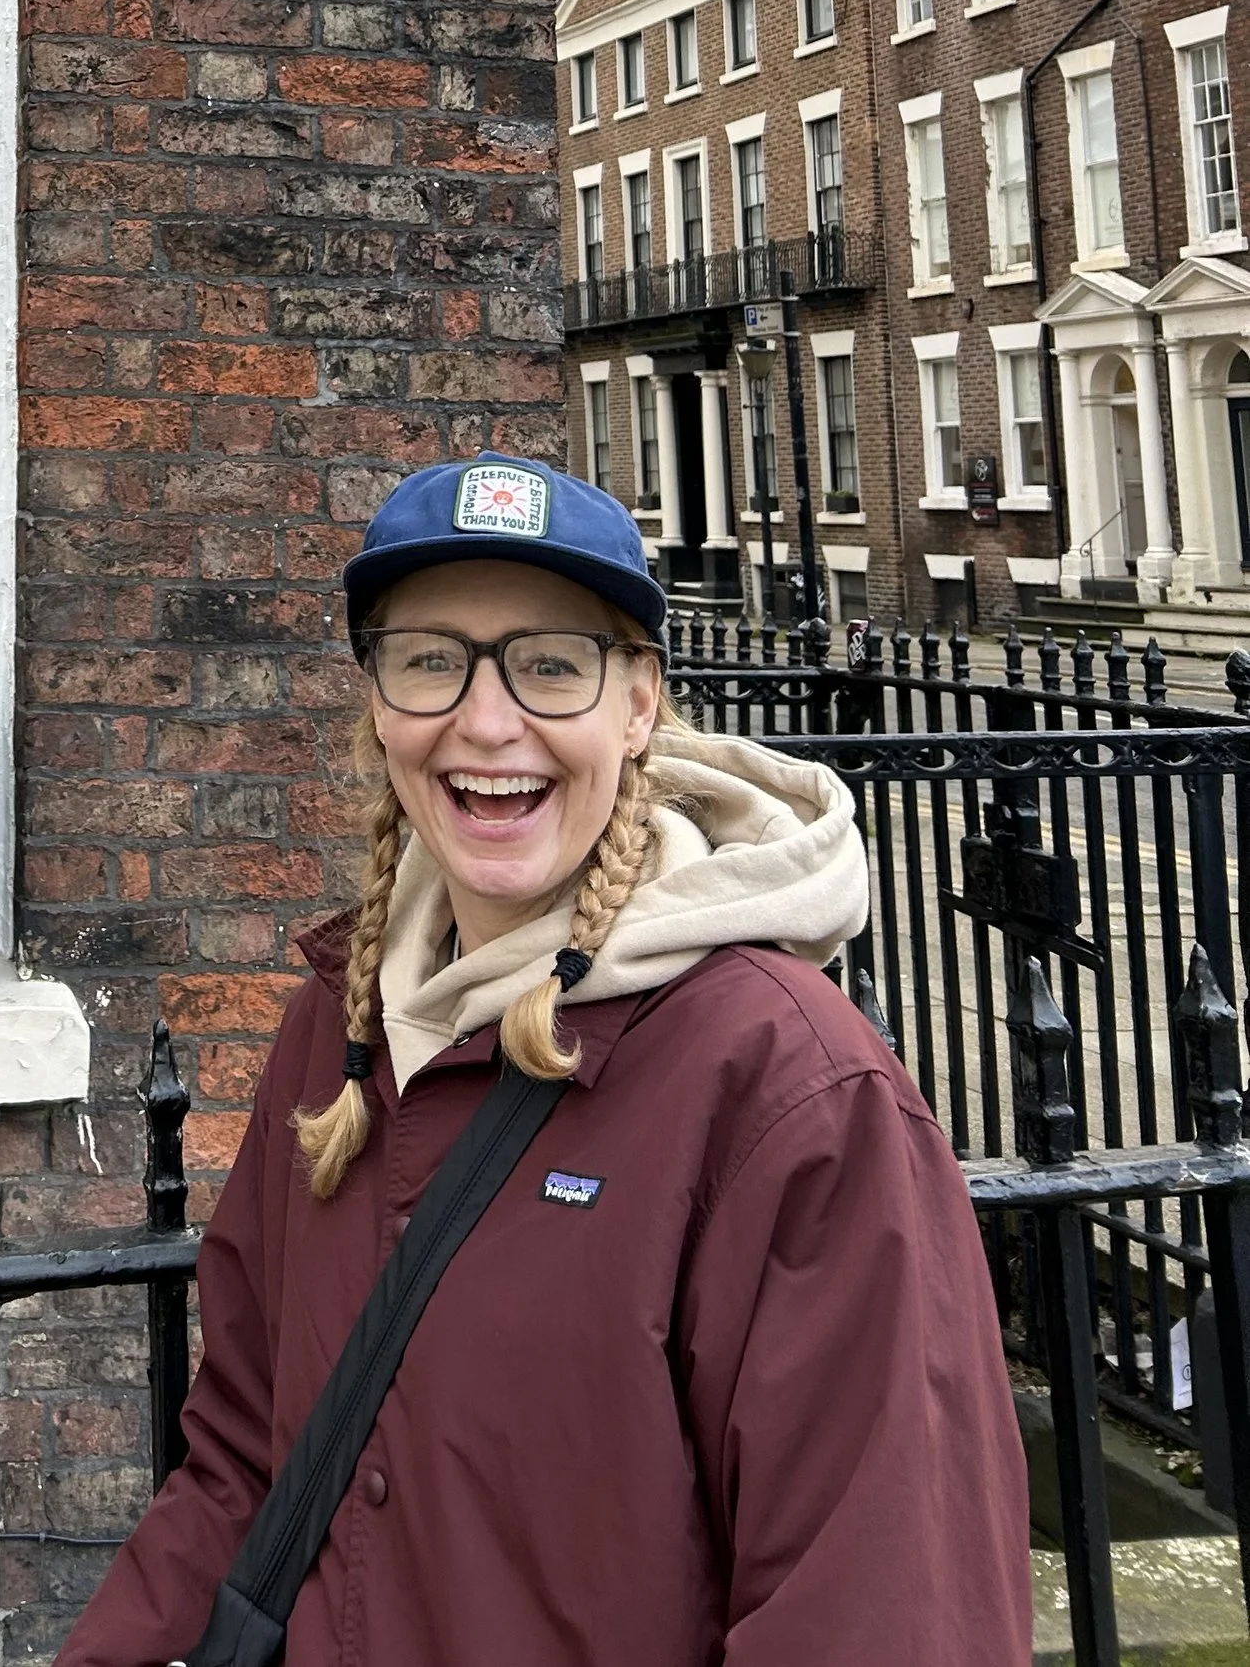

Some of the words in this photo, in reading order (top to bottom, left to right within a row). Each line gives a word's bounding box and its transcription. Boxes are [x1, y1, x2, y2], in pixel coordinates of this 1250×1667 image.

[468, 472, 479, 482] IT
[480, 470, 525, 484] LEAVE
[529, 478, 543, 488] IT
[463, 484, 478, 513] FOUND
[527, 488, 542, 531] BETTER
[462, 514, 497, 526] THAN
[501, 516, 526, 530] YOU
[852, 631, 863, 649] D
[849, 642, 866, 666] Pep
